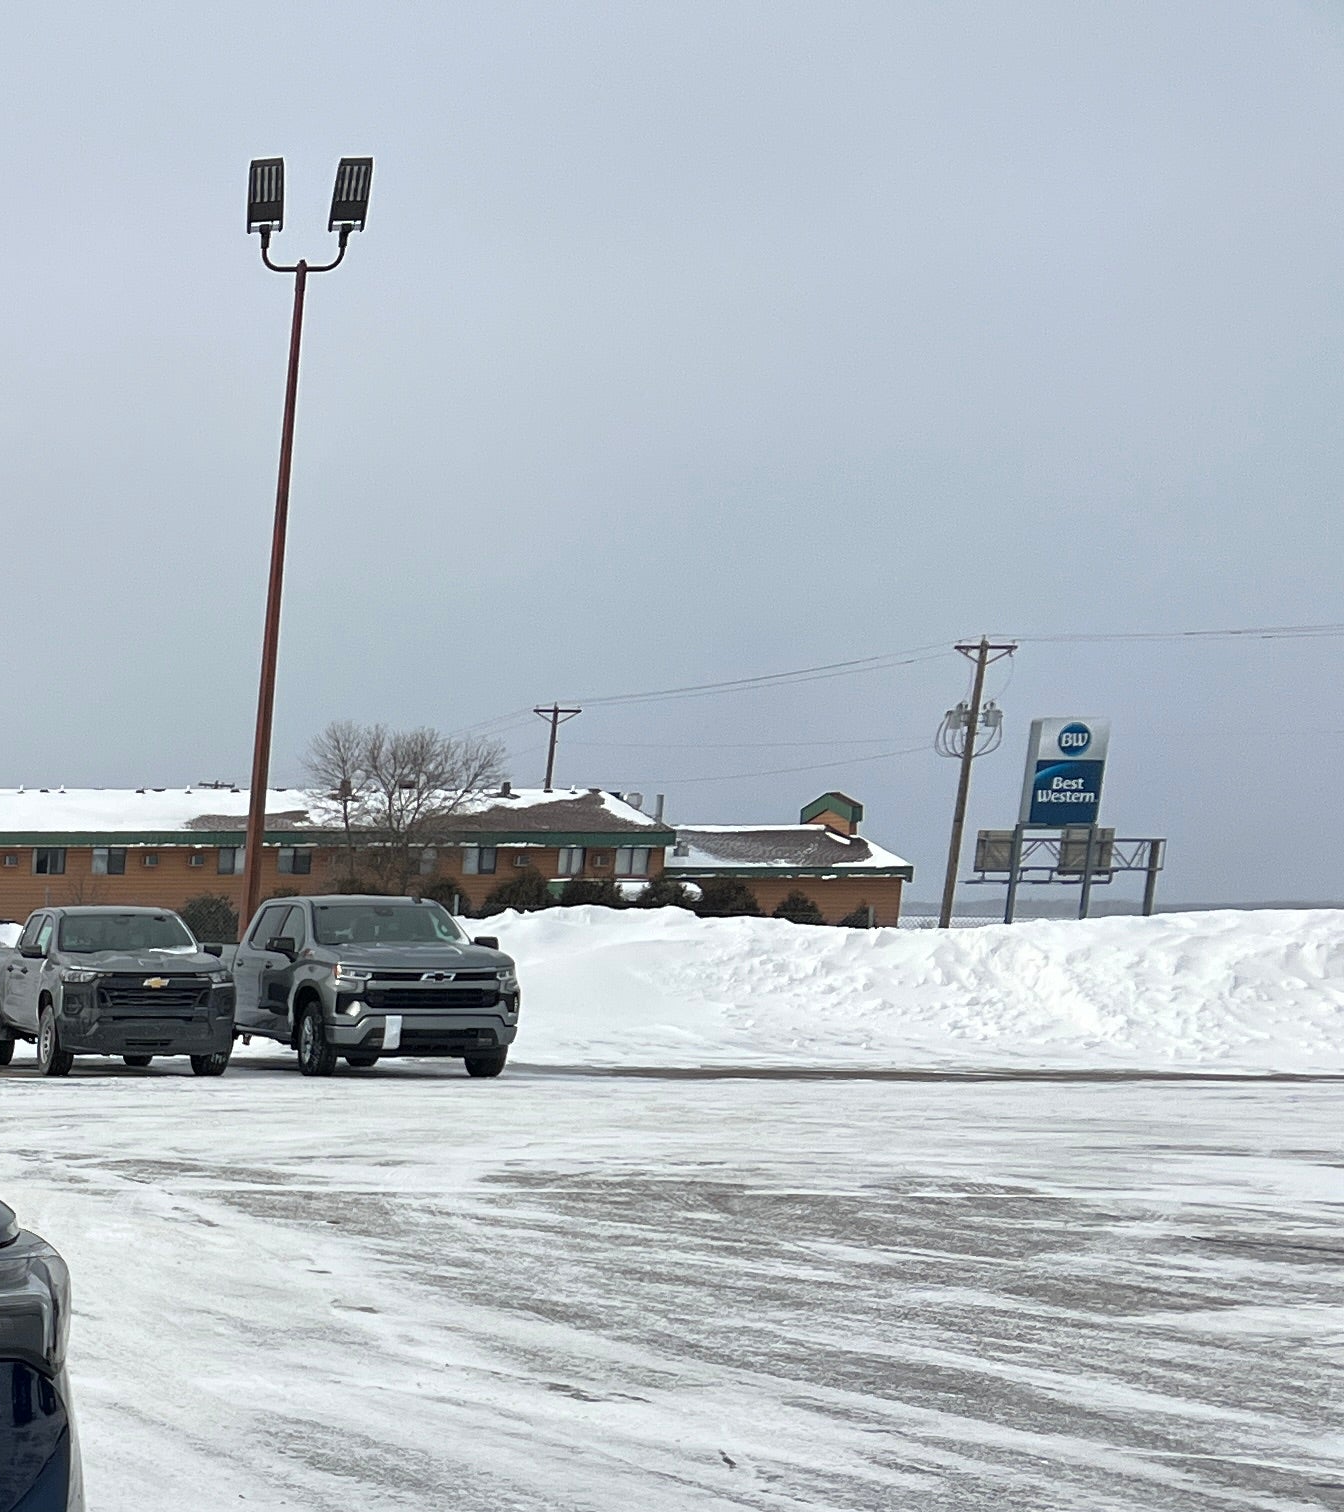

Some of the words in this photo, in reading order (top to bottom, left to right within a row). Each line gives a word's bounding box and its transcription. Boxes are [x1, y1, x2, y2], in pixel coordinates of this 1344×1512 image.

[1060, 732, 1089, 747] BW
[1052, 776, 1085, 790] Best
[1037, 789, 1095, 803] Western
